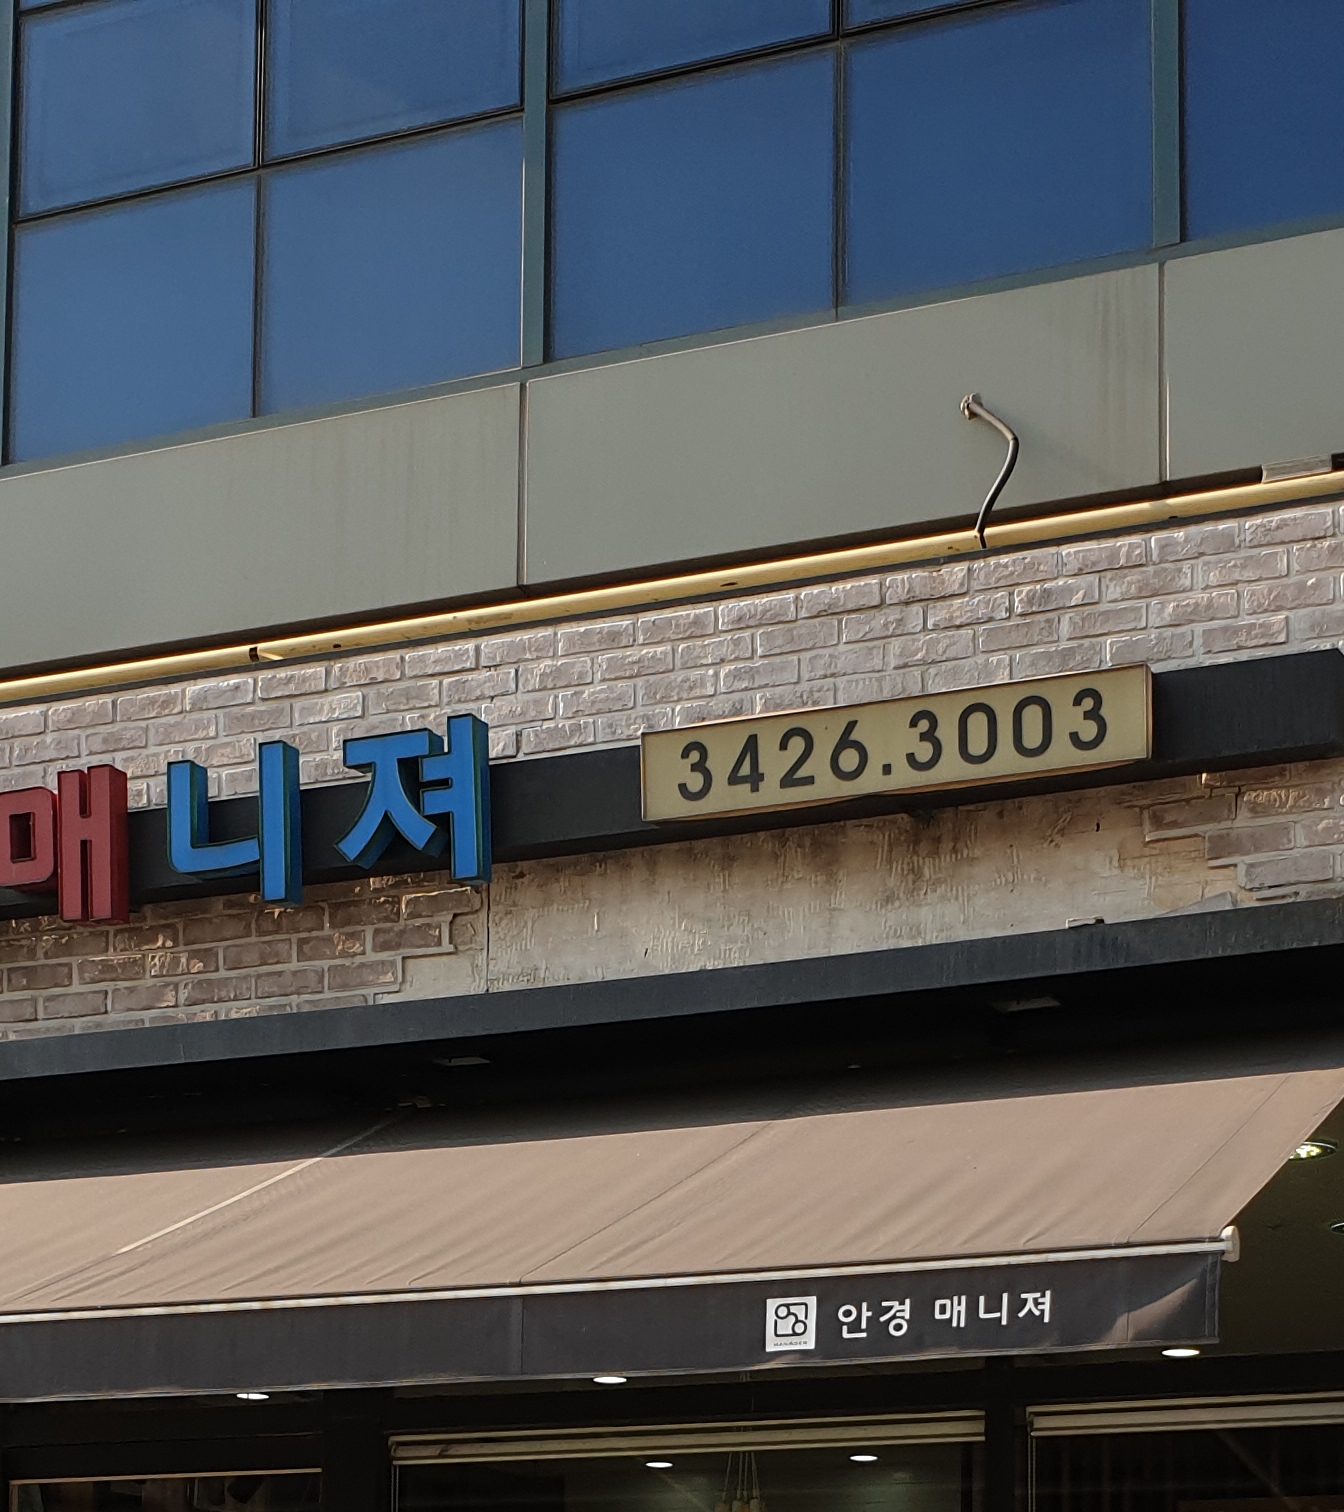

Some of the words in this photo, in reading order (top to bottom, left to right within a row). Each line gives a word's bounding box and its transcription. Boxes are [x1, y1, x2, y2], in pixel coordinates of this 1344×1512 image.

[677, 688, 1109, 803] 3426.3003
[837, 1299, 912, 1339] 안경
[933, 1290, 1052, 1329] 매니져
